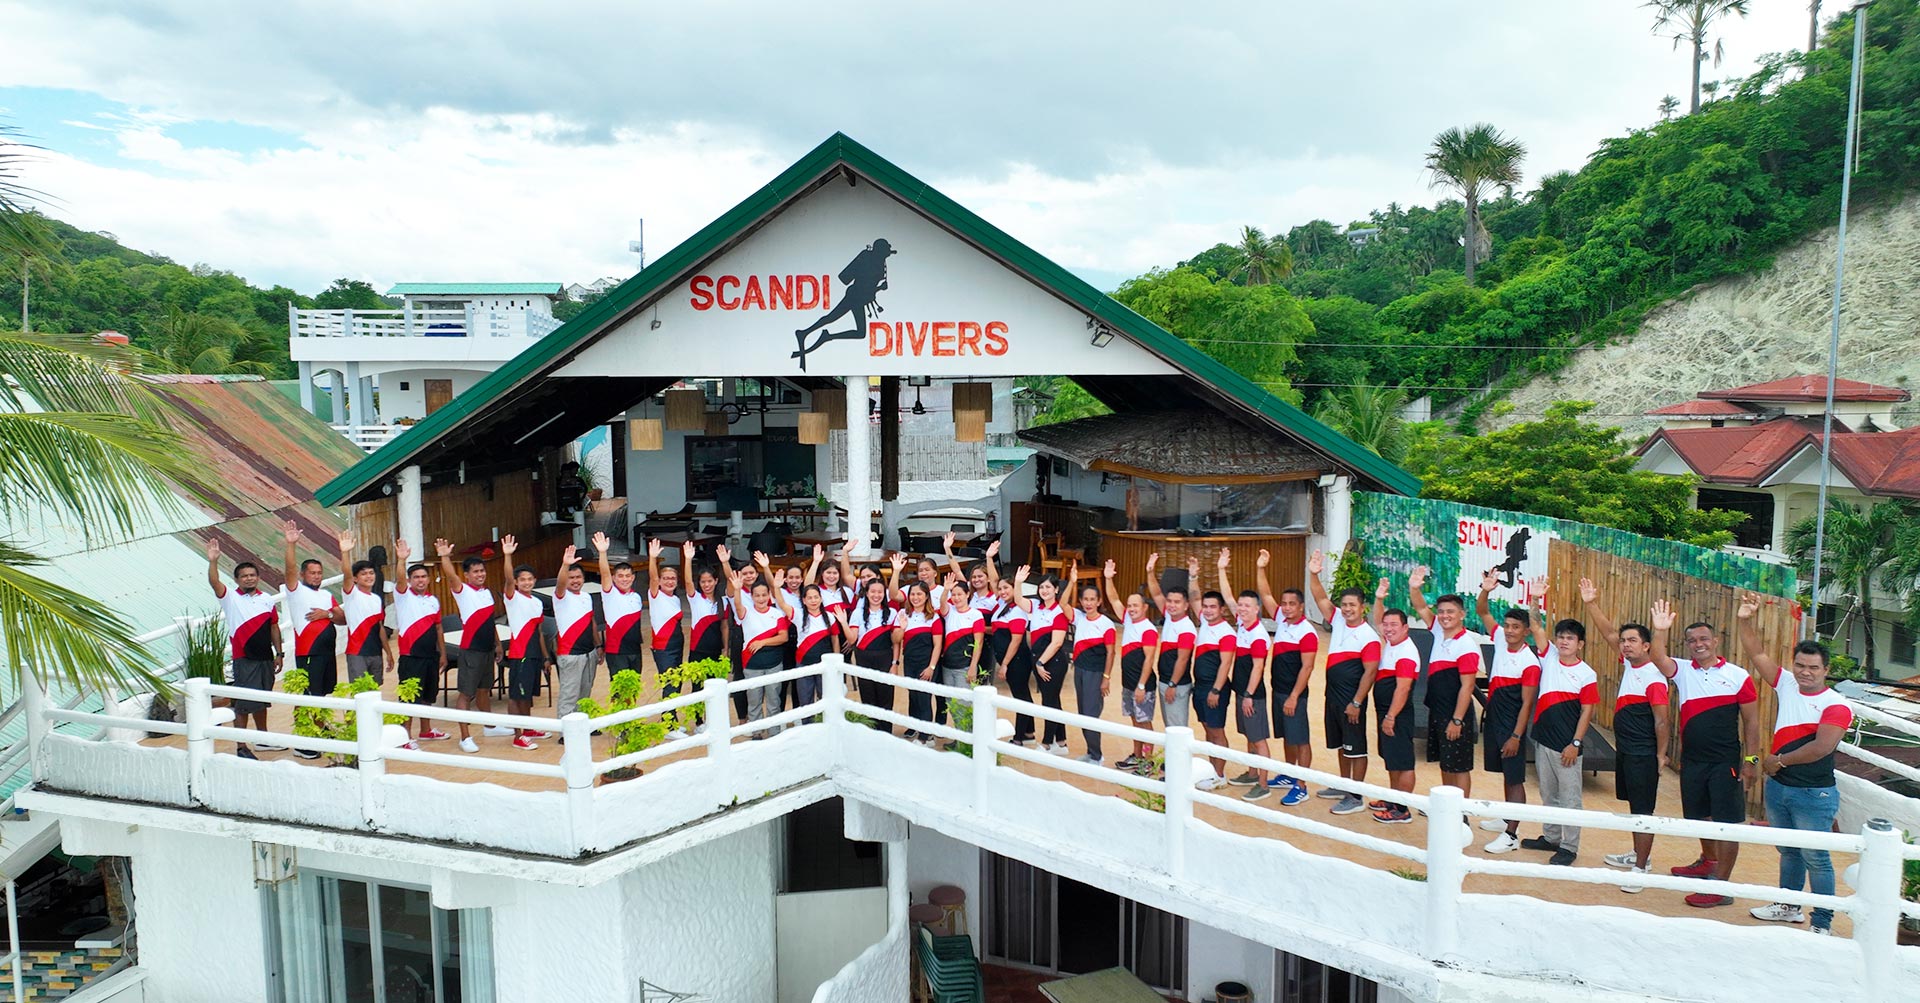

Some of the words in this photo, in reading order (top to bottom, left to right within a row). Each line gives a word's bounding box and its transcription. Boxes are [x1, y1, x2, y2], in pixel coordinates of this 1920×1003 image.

[690, 274, 830, 311] SCANDI
[869, 321, 1009, 357] DIVERS
[1458, 520, 1503, 551] SCANDI
